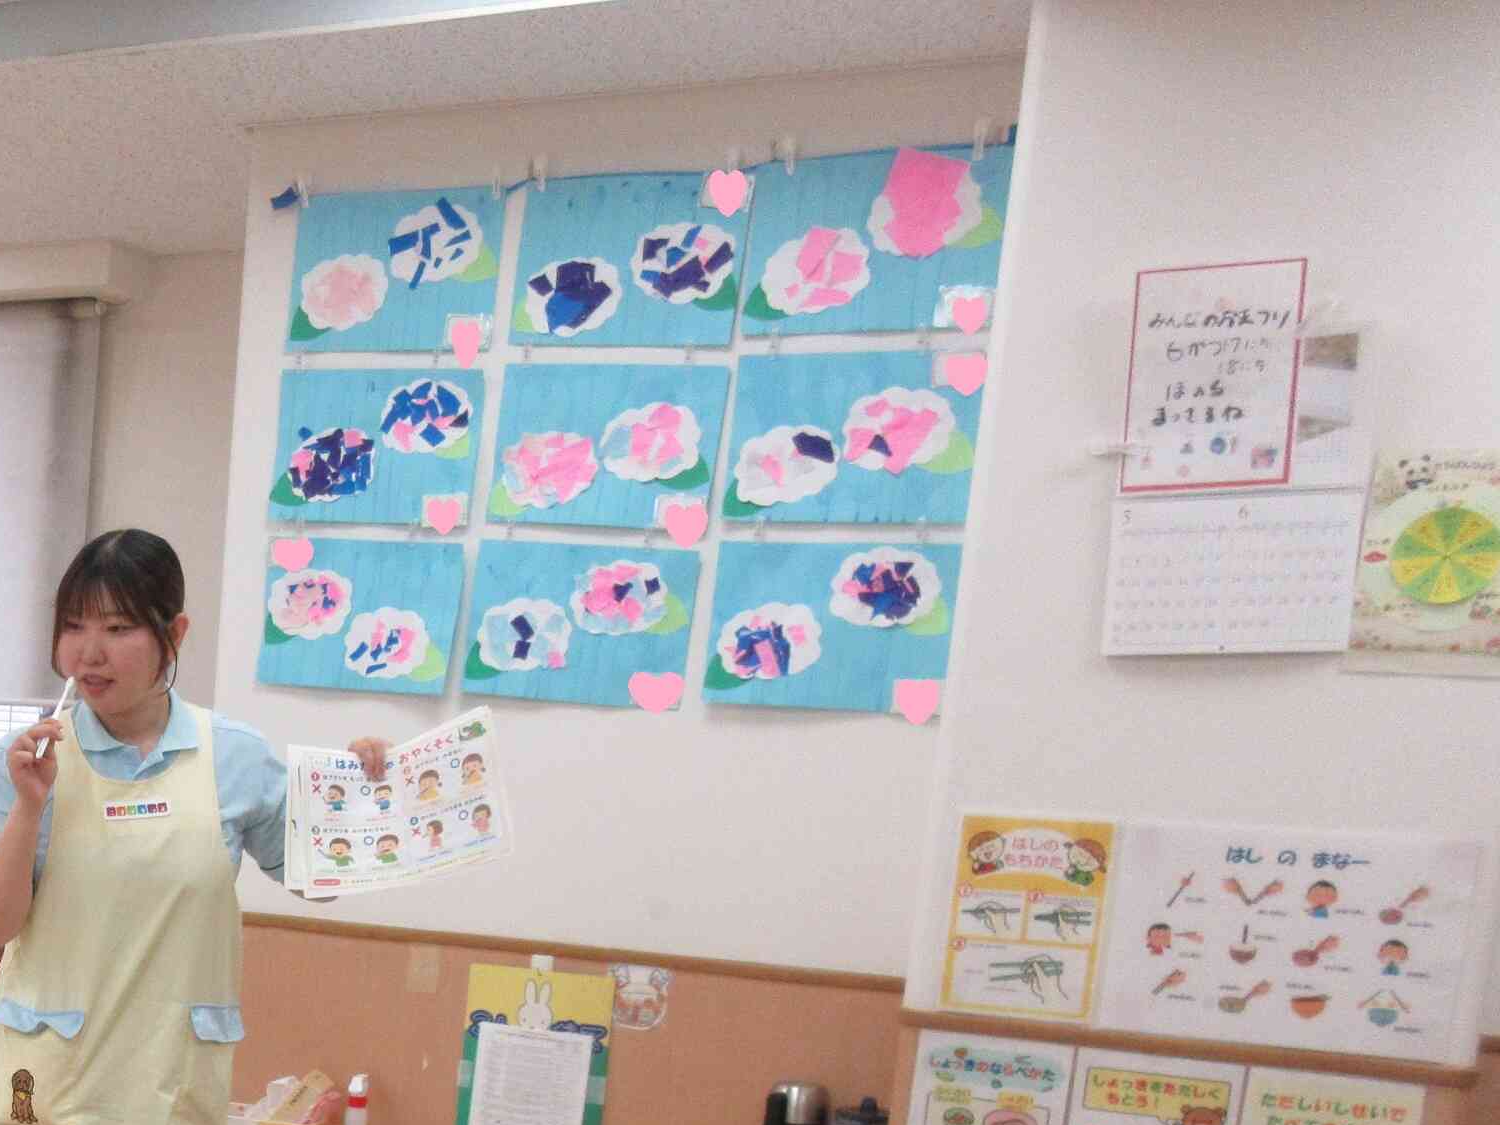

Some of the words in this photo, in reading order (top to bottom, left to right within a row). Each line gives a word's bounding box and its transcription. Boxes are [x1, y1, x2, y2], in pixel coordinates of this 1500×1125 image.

[1225, 846, 1263, 864] はし
[1277, 850, 1297, 865] の
[1311, 852, 1371, 870] まなー
[1260, 1092, 1408, 1123] ただしいしせいで
